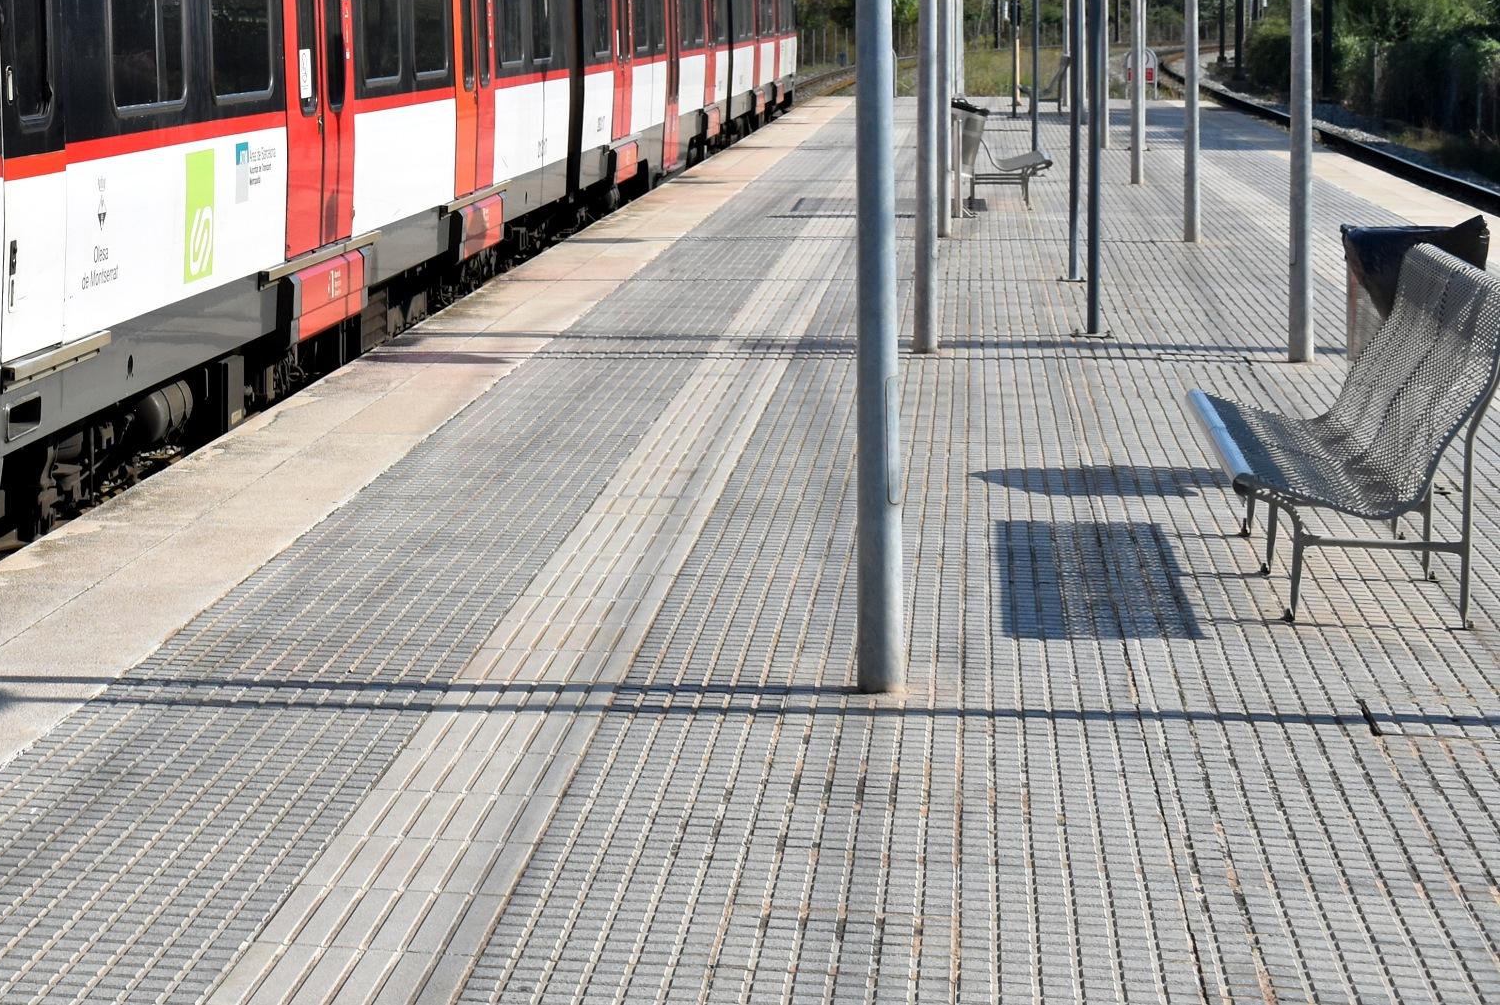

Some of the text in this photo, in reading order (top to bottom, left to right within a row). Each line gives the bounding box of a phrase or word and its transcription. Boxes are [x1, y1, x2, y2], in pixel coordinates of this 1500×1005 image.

[93, 245, 109, 263] Olesa
[81, 263, 119, 290] de Montserrat
